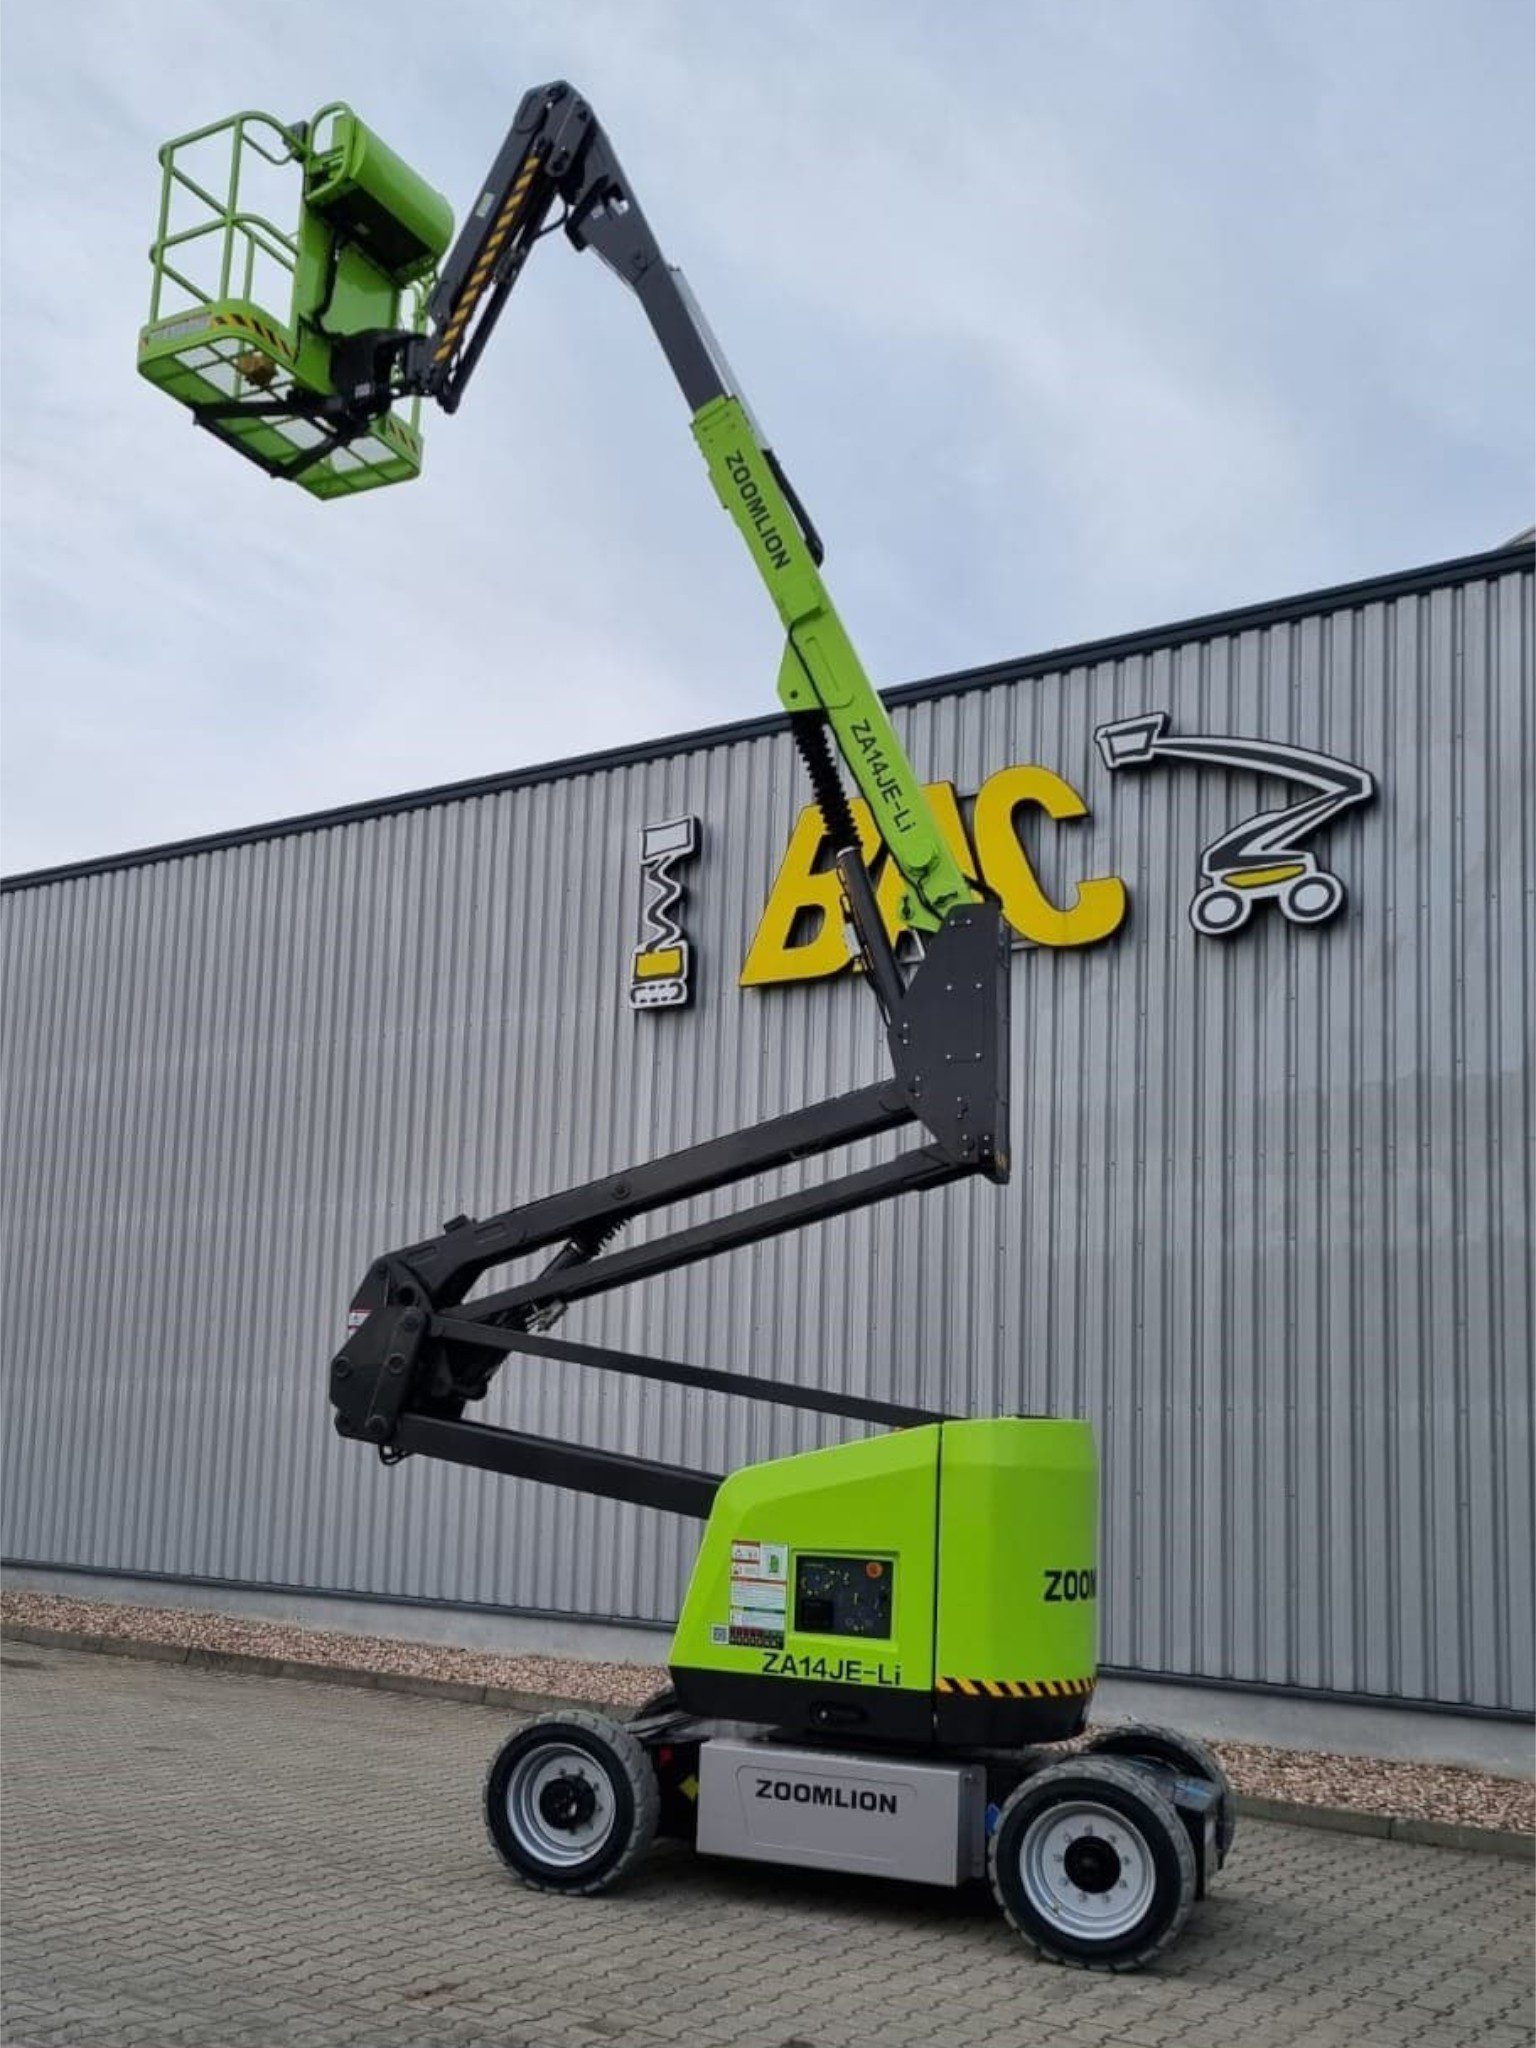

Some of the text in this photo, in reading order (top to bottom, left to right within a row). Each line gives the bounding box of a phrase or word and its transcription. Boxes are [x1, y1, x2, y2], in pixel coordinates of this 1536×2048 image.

[725, 450, 791, 570] ZOOMLION
[850, 718, 916, 833] ZA14JE-Li
[763, 1653, 901, 1686] ZA14JE-Li
[755, 1778, 896, 1814] ZOOMLION
